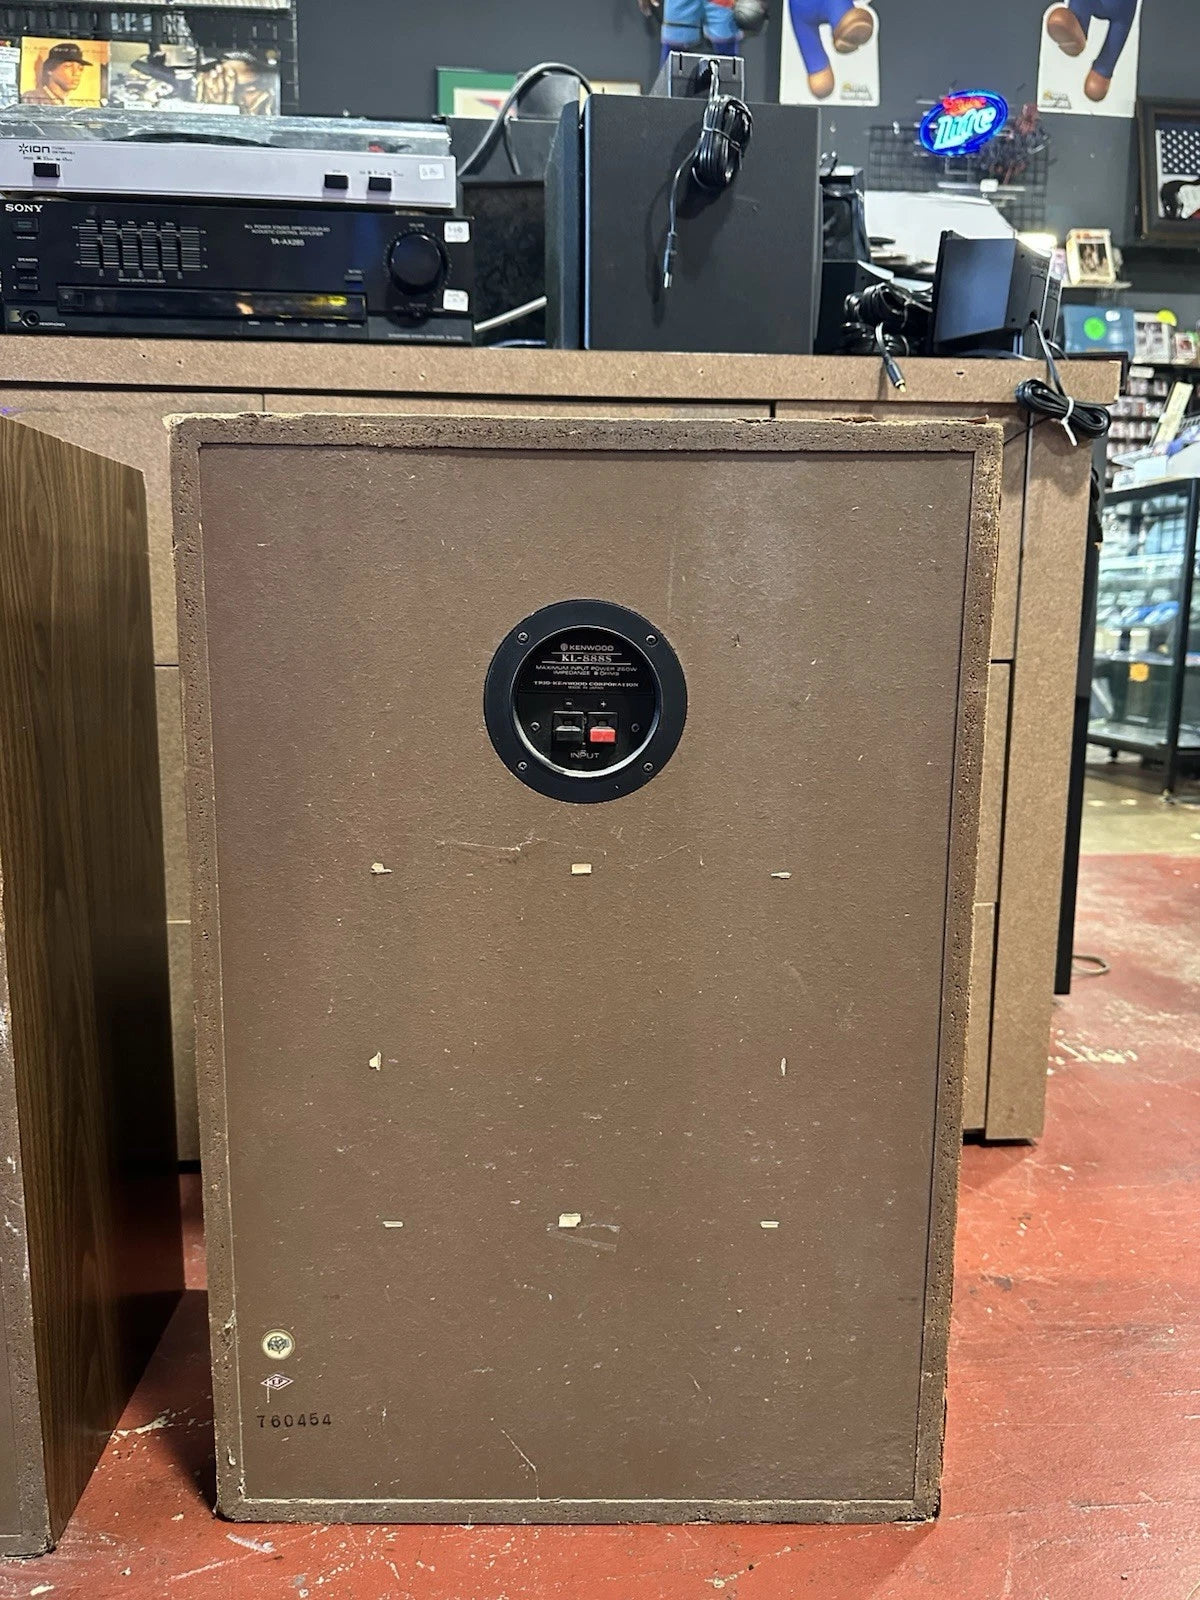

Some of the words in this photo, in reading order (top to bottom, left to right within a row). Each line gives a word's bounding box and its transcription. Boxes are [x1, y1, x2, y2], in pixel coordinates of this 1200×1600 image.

[5, 203, 43, 212] SONY
[569, 644, 614, 652] KENWOOD
[570, 752, 600, 760] INPUT
[256, 1412, 332, 1428] 760454
